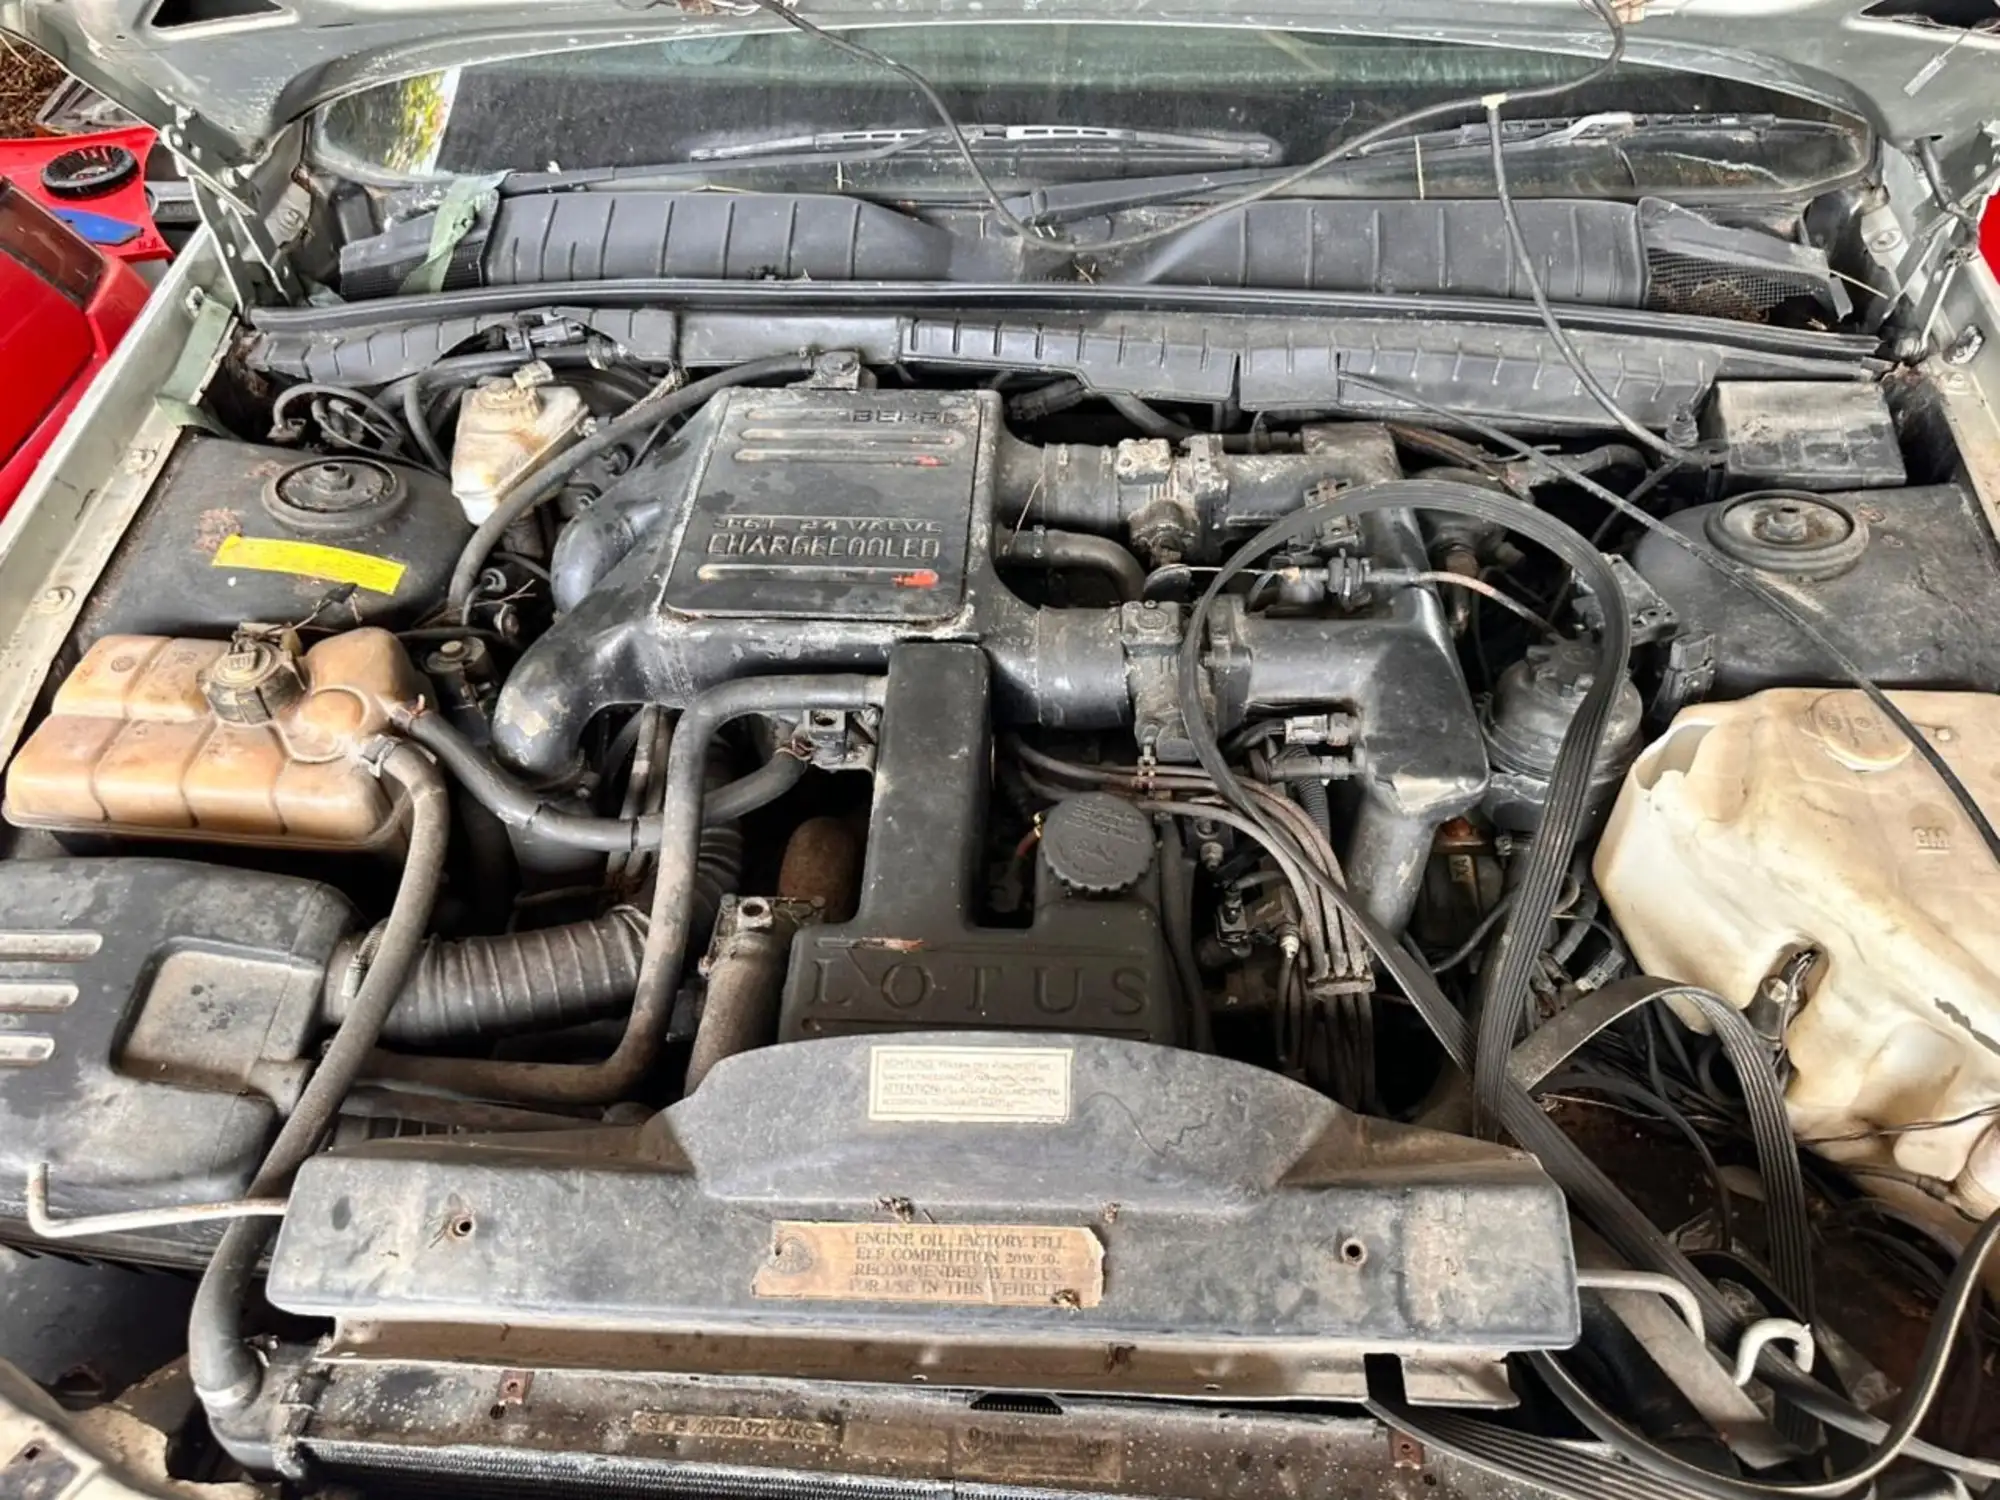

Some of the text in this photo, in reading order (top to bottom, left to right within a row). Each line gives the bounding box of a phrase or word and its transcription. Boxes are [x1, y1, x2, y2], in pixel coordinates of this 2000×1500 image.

[847, 517, 943, 534] VALVE
[706, 531, 941, 559] CHARGECOOLED
[811, 956, 1152, 1016] LOTUS
[854, 1231, 914, 1246] ENGINE
[920, 1233, 946, 1247] OIL
[958, 1233, 1029, 1249] FACTORY
[891, 1247, 999, 1263] COMPETITION
[853, 1262, 978, 1278] RECOMMENDED
[921, 1280, 939, 1294] IN
[944, 1280, 984, 1295] THIS
